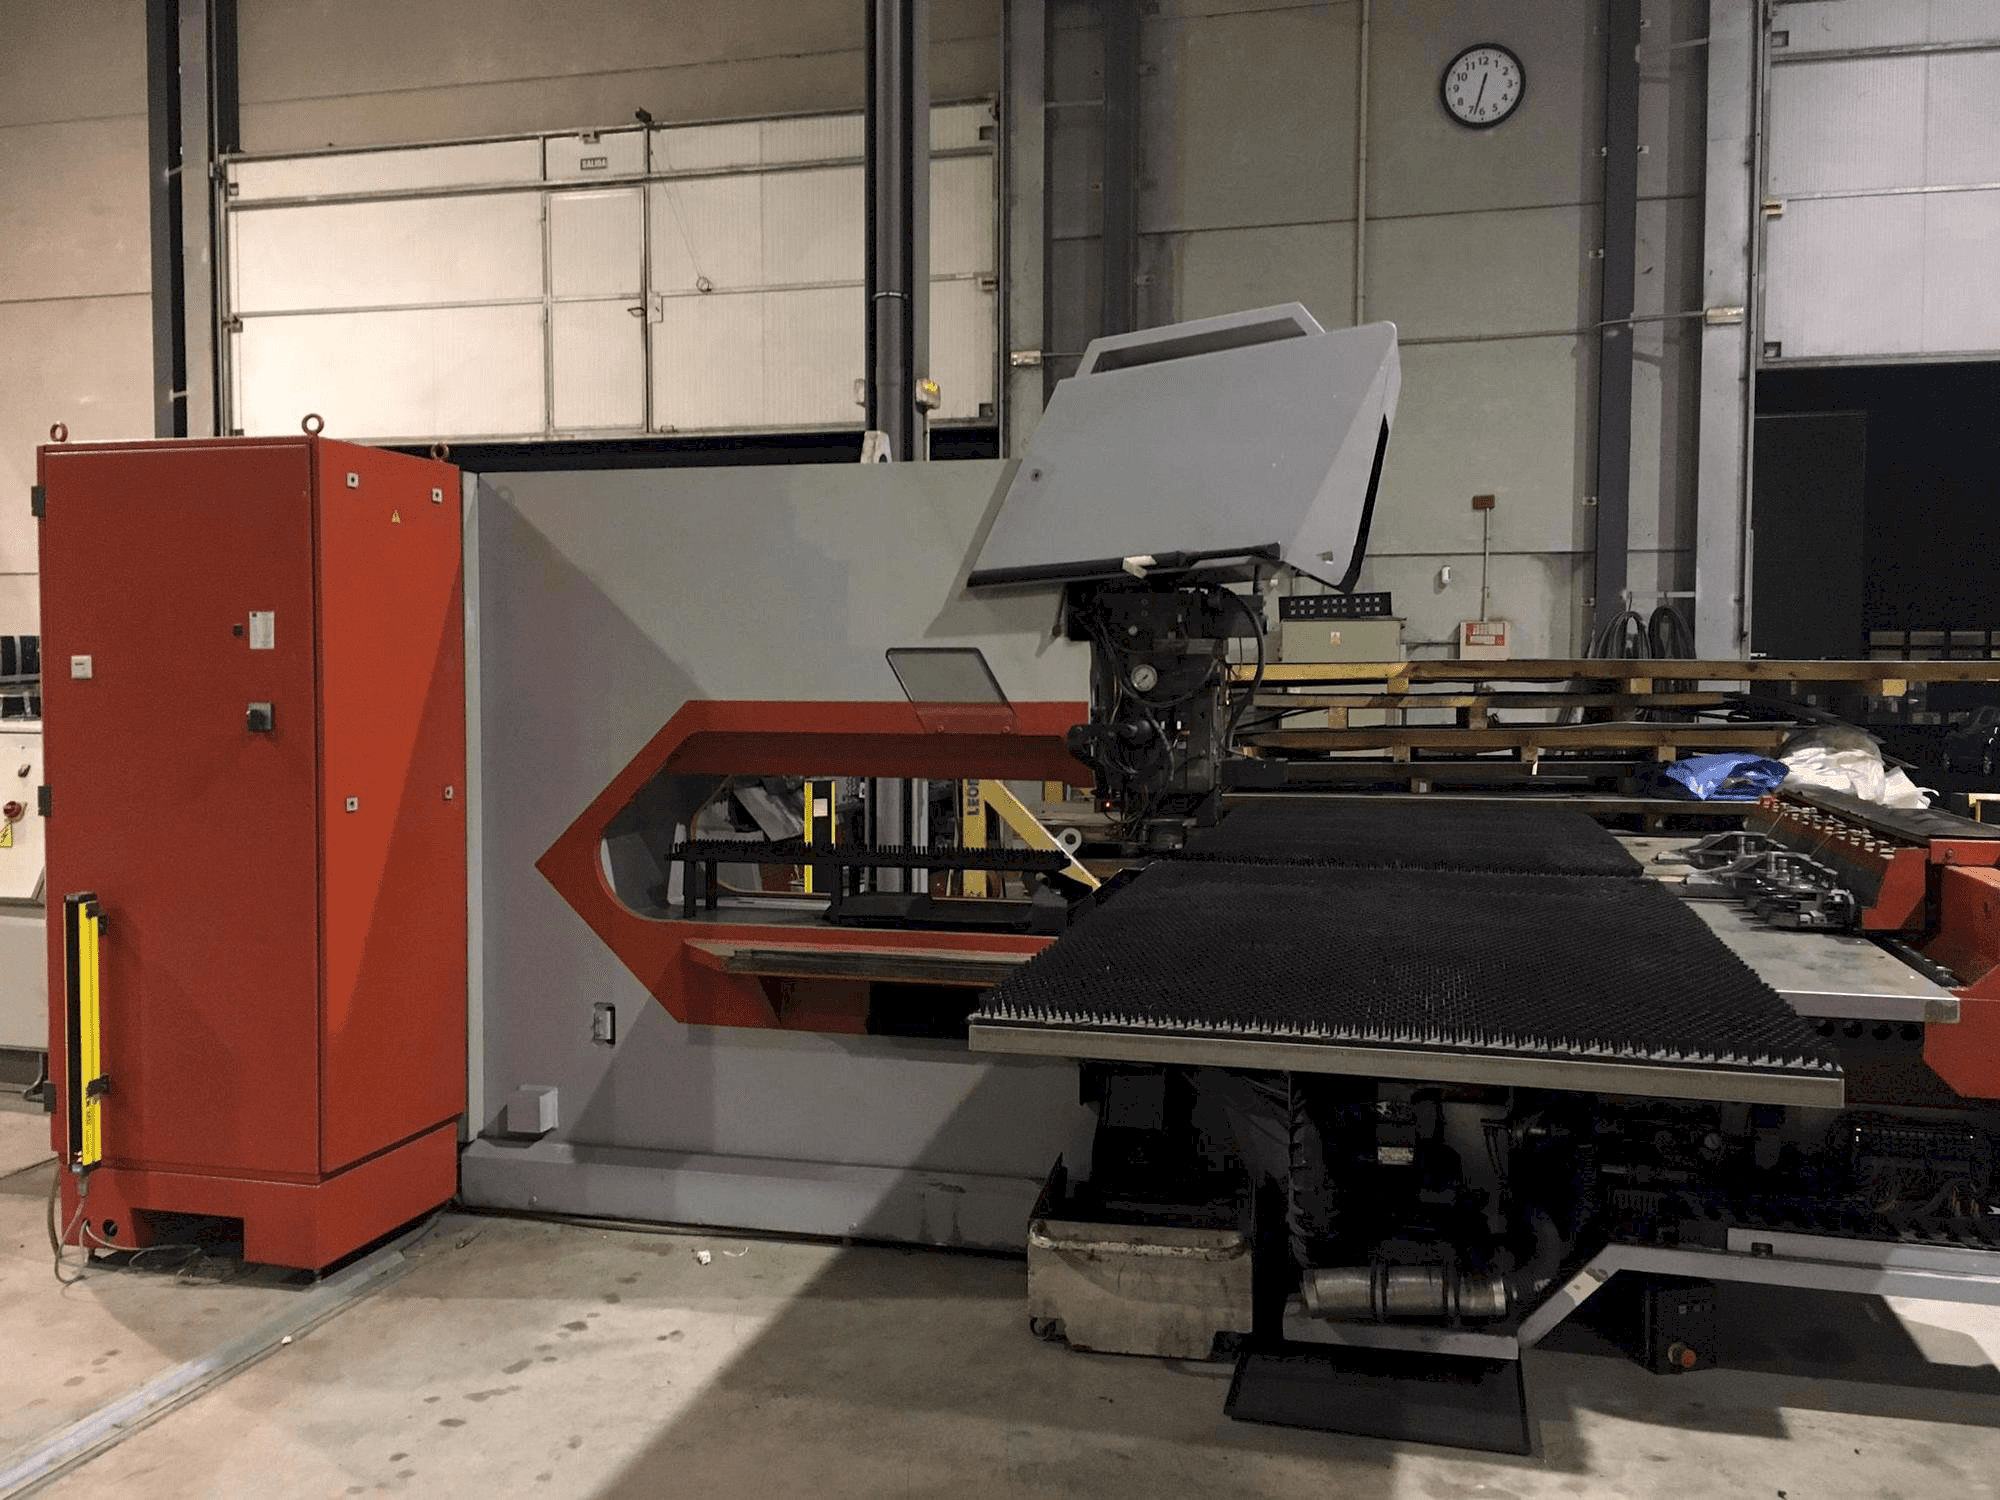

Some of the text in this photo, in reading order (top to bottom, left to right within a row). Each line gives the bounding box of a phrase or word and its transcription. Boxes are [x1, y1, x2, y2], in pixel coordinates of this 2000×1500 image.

[1478, 56, 1490, 66] 12
[1494, 59, 1499, 68] 1
[1465, 62, 1476, 71] 11
[1502, 66, 1509, 76] 2
[1456, 72, 1468, 82] 10
[1453, 84, 1460, 92] 9
[1506, 79, 1513, 88] 3
[1457, 97, 1464, 106] 8
[1501, 93, 1508, 101] 4
[1468, 105, 1474, 114] 7
[1479, 107, 1485, 115] 6
[1492, 103, 1498, 112] 5
[581, 158, 606, 169] SALIDA
